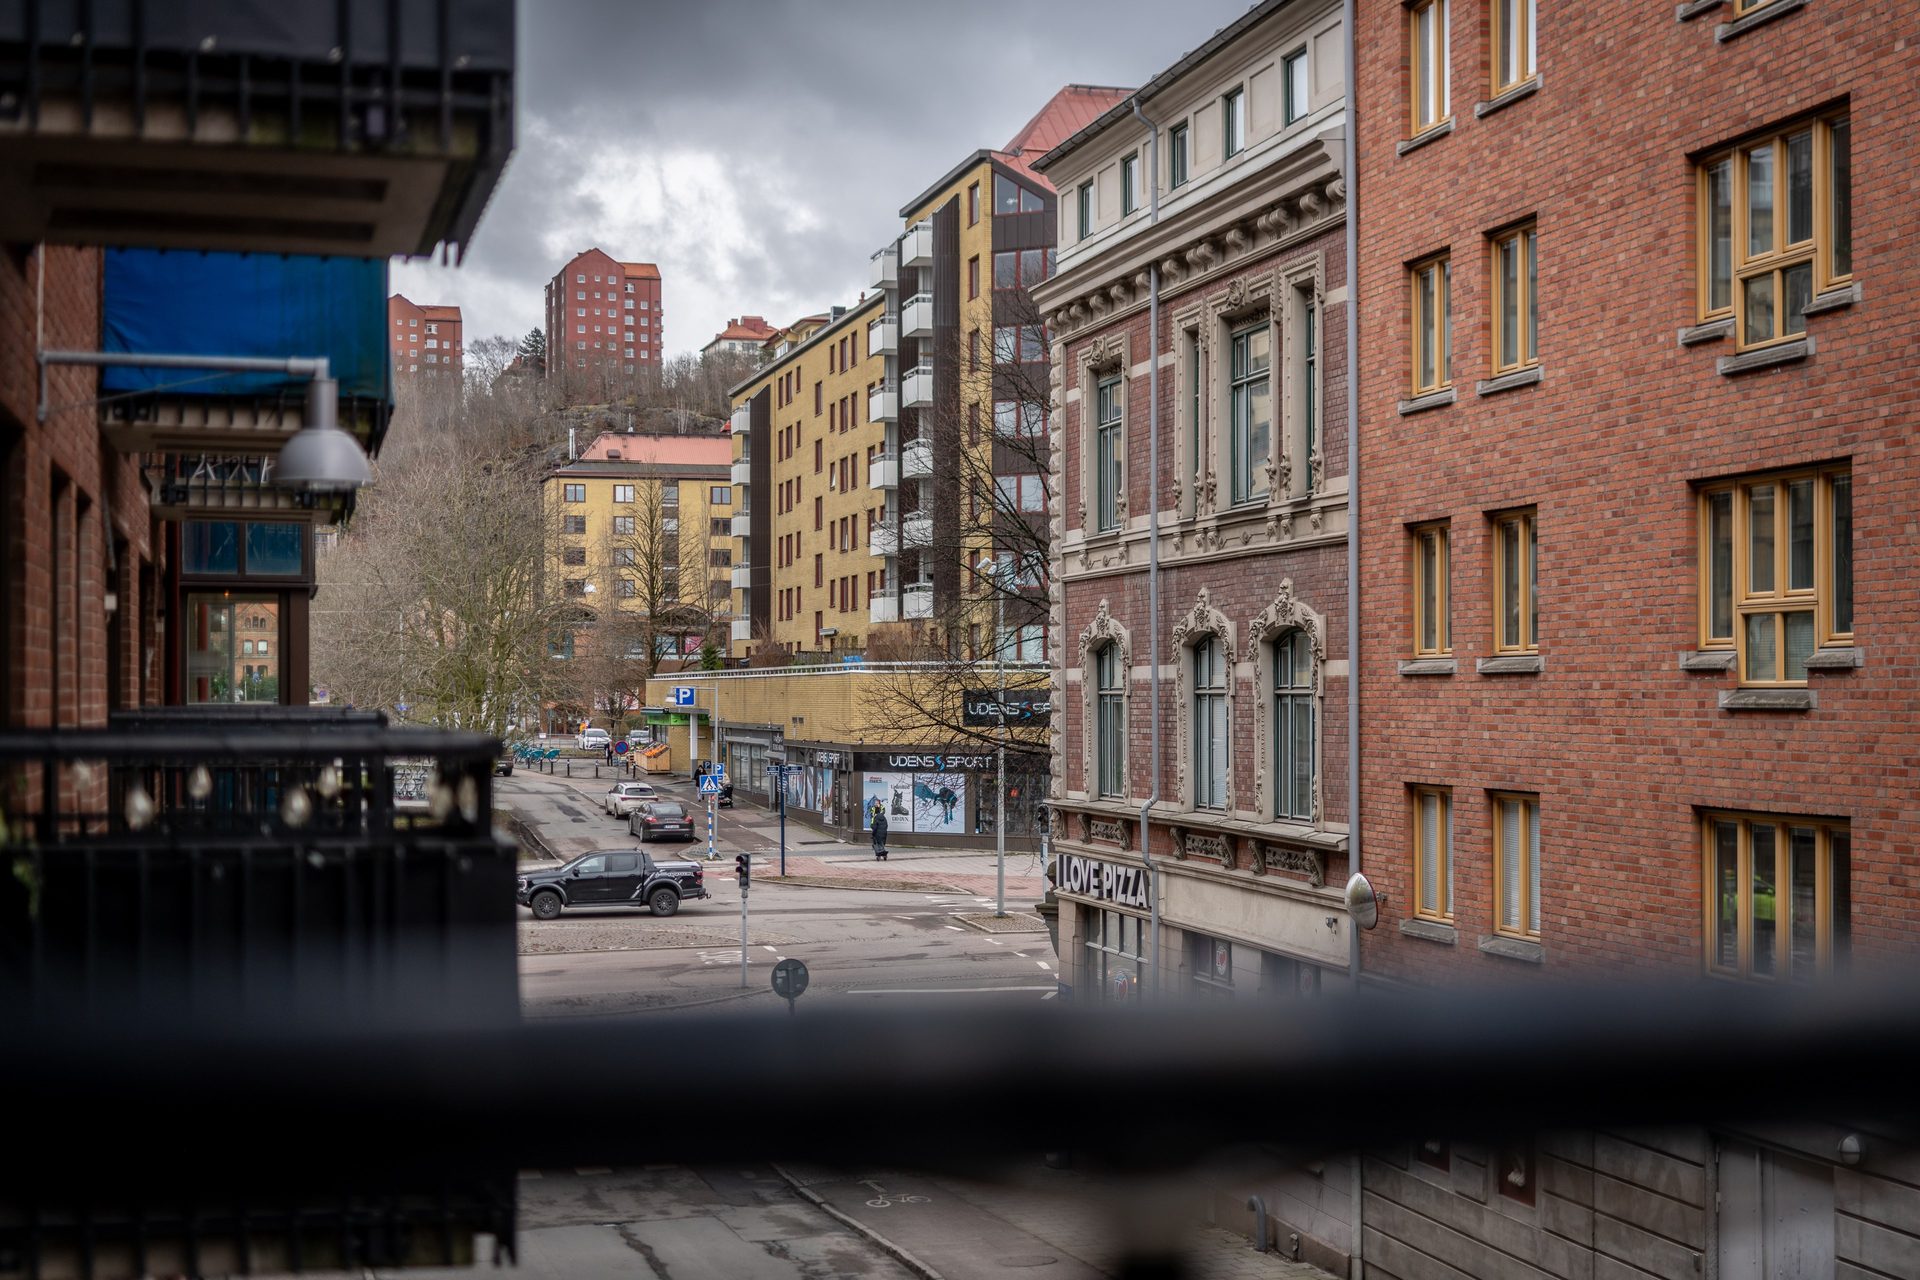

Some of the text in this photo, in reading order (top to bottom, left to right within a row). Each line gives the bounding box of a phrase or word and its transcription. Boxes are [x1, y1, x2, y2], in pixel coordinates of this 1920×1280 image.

[679, 688, 691, 704] P
[968, 702, 1020, 715] UDENS
[889, 755, 992, 768] UDENS SPORT
[1063, 855, 1100, 897] LOVE
[1103, 863, 1148, 909] PIZZA
